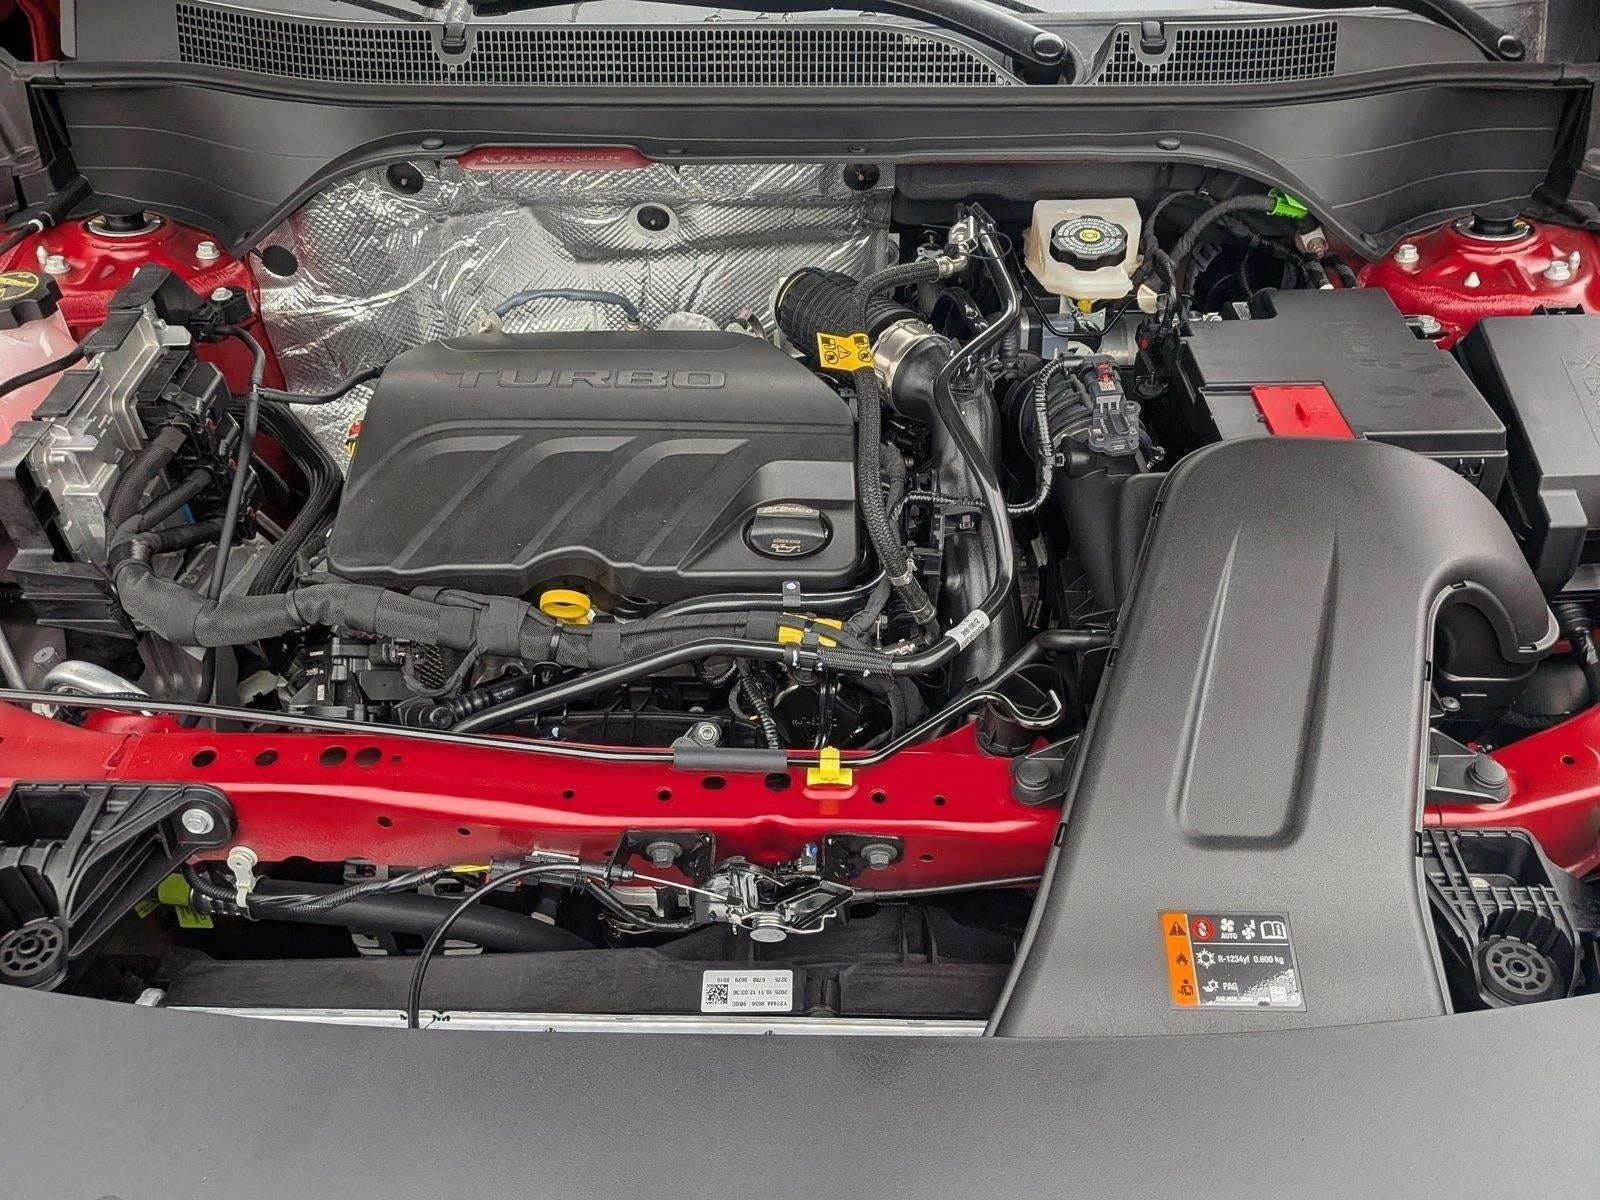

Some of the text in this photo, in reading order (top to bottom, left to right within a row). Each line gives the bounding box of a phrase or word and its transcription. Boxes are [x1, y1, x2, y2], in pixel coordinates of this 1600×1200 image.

[445, 369, 727, 389] TURBO
[1217, 955, 1285, 965] R-1234yf 0.600 kg
[1222, 982, 1238, 991] PAG
